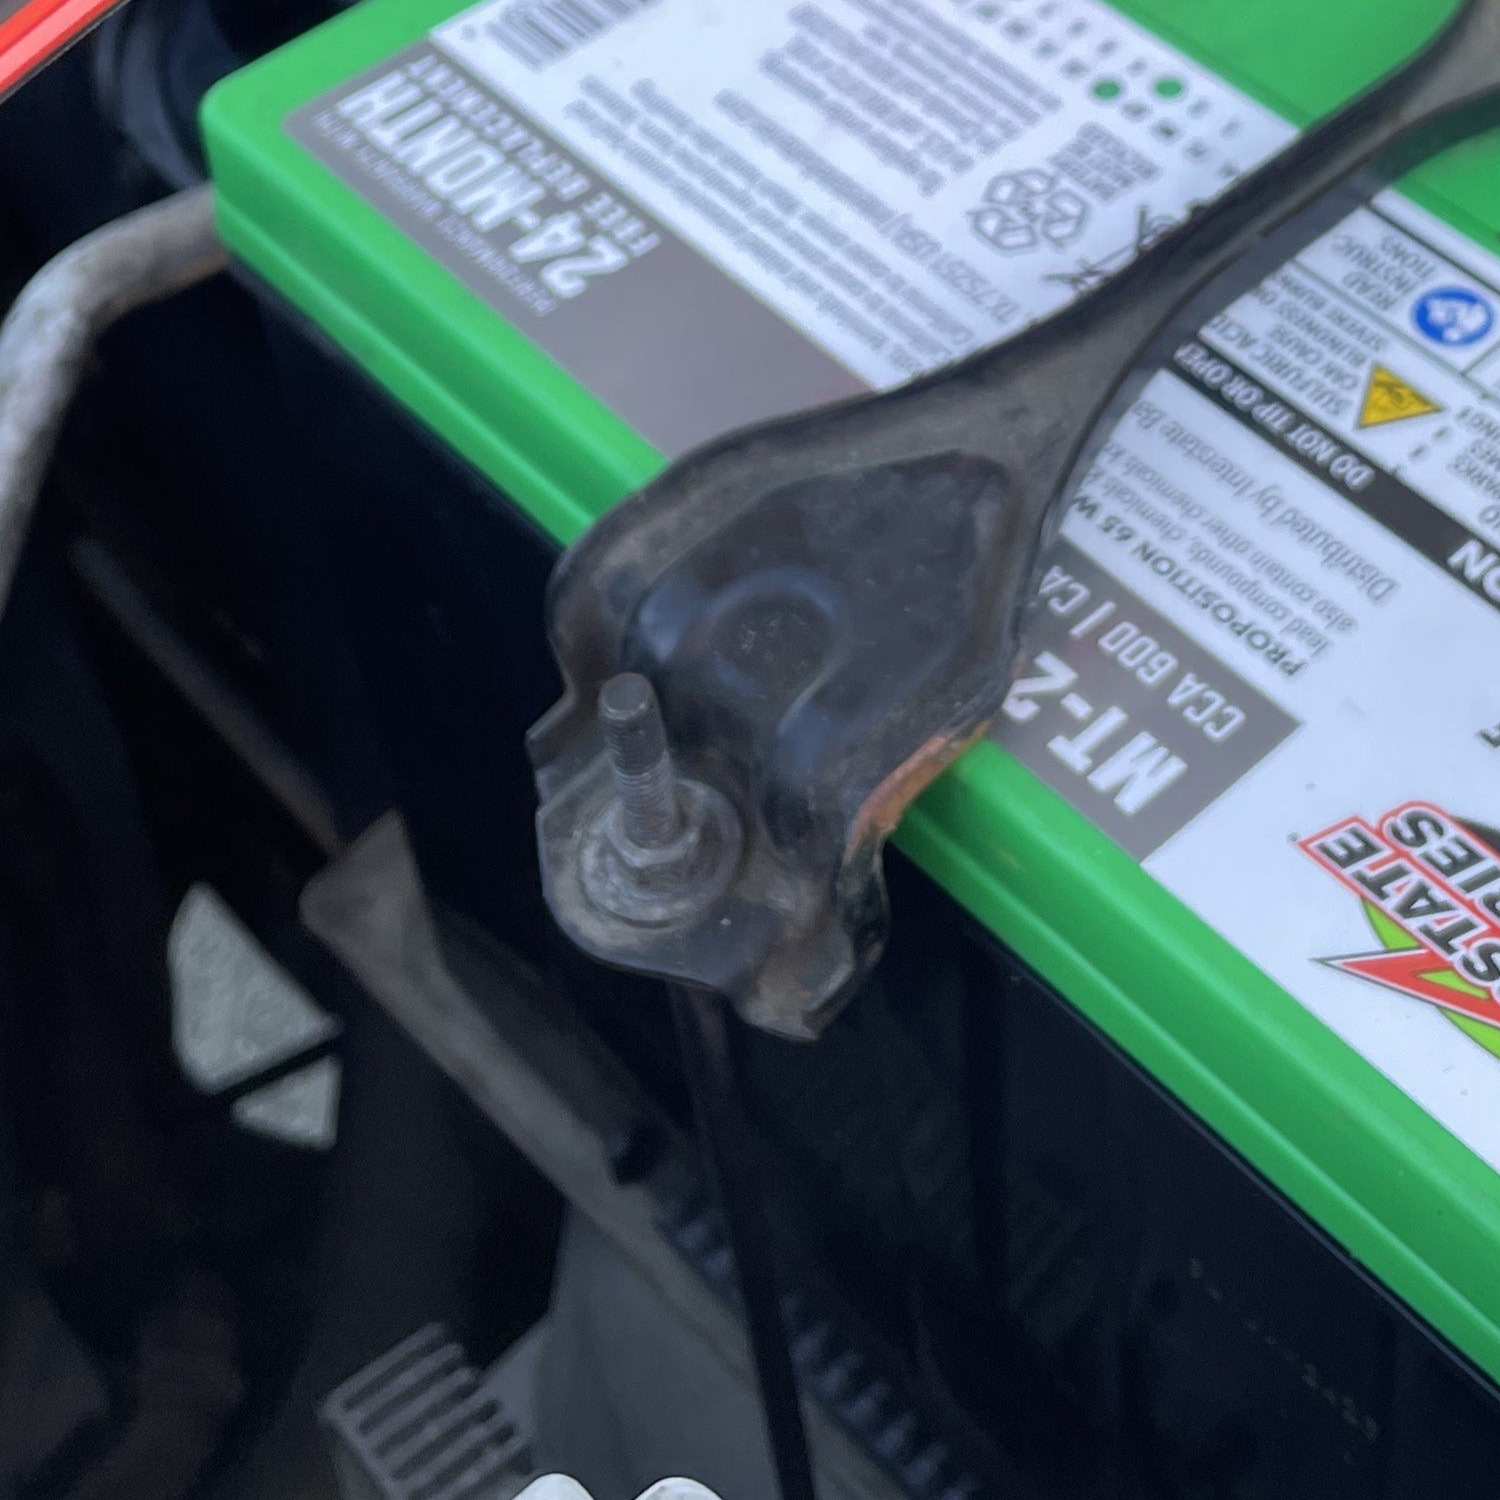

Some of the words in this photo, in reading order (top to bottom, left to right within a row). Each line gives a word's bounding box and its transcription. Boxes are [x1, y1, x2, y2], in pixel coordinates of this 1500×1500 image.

[400, 51, 597, 203] REPLACEMENT
[330, 67, 634, 303] 24-MONTH
[572, 188, 666, 258] FREE
[1337, 270, 1397, 313] READ
[1263, 321, 1327, 367] CAUSE
[1217, 372, 1266, 409] OR
[1248, 395, 1297, 431] TIP
[1249, 342, 1354, 417] SULFURIC
[1149, 416, 1258, 499] Interstate
[1283, 419, 1338, 461] NOT
[1325, 449, 1376, 488] DO
[1091, 471, 1189, 547] chemicals
[1114, 453, 1207, 524] chemicals
[1242, 480, 1291, 519] by
[1093, 511, 1139, 547] 65
[1267, 503, 1399, 604] Distributed
[1127, 538, 1307, 679] PROPOSITION
[1174, 534, 1294, 628] compounds,
[1242, 549, 1319, 609] contain
[1277, 613, 1334, 659] lead
[1304, 595, 1357, 638] also
[1093, 617, 1181, 688] 600
[987, 647, 1189, 816] MT-2
[1159, 669, 1249, 743] CCA
